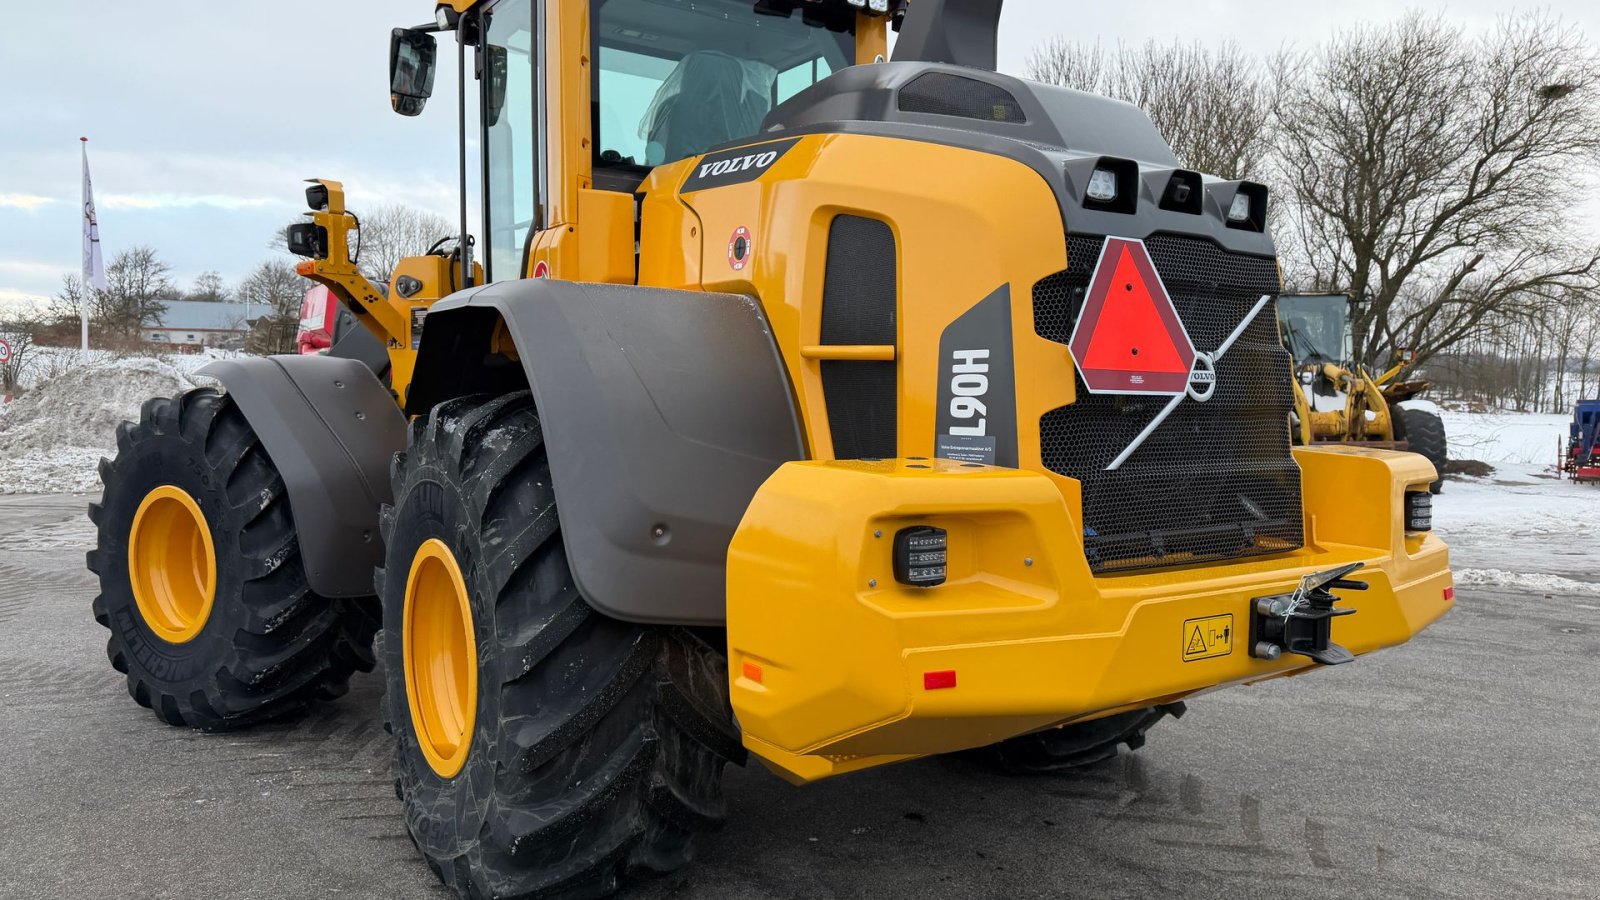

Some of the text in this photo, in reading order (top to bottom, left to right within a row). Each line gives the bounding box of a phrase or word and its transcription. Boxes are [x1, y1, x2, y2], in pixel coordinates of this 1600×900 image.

[699, 151, 778, 178] VOLVO
[949, 349, 990, 436] L90H
[116, 610, 193, 682] MICHELIN
